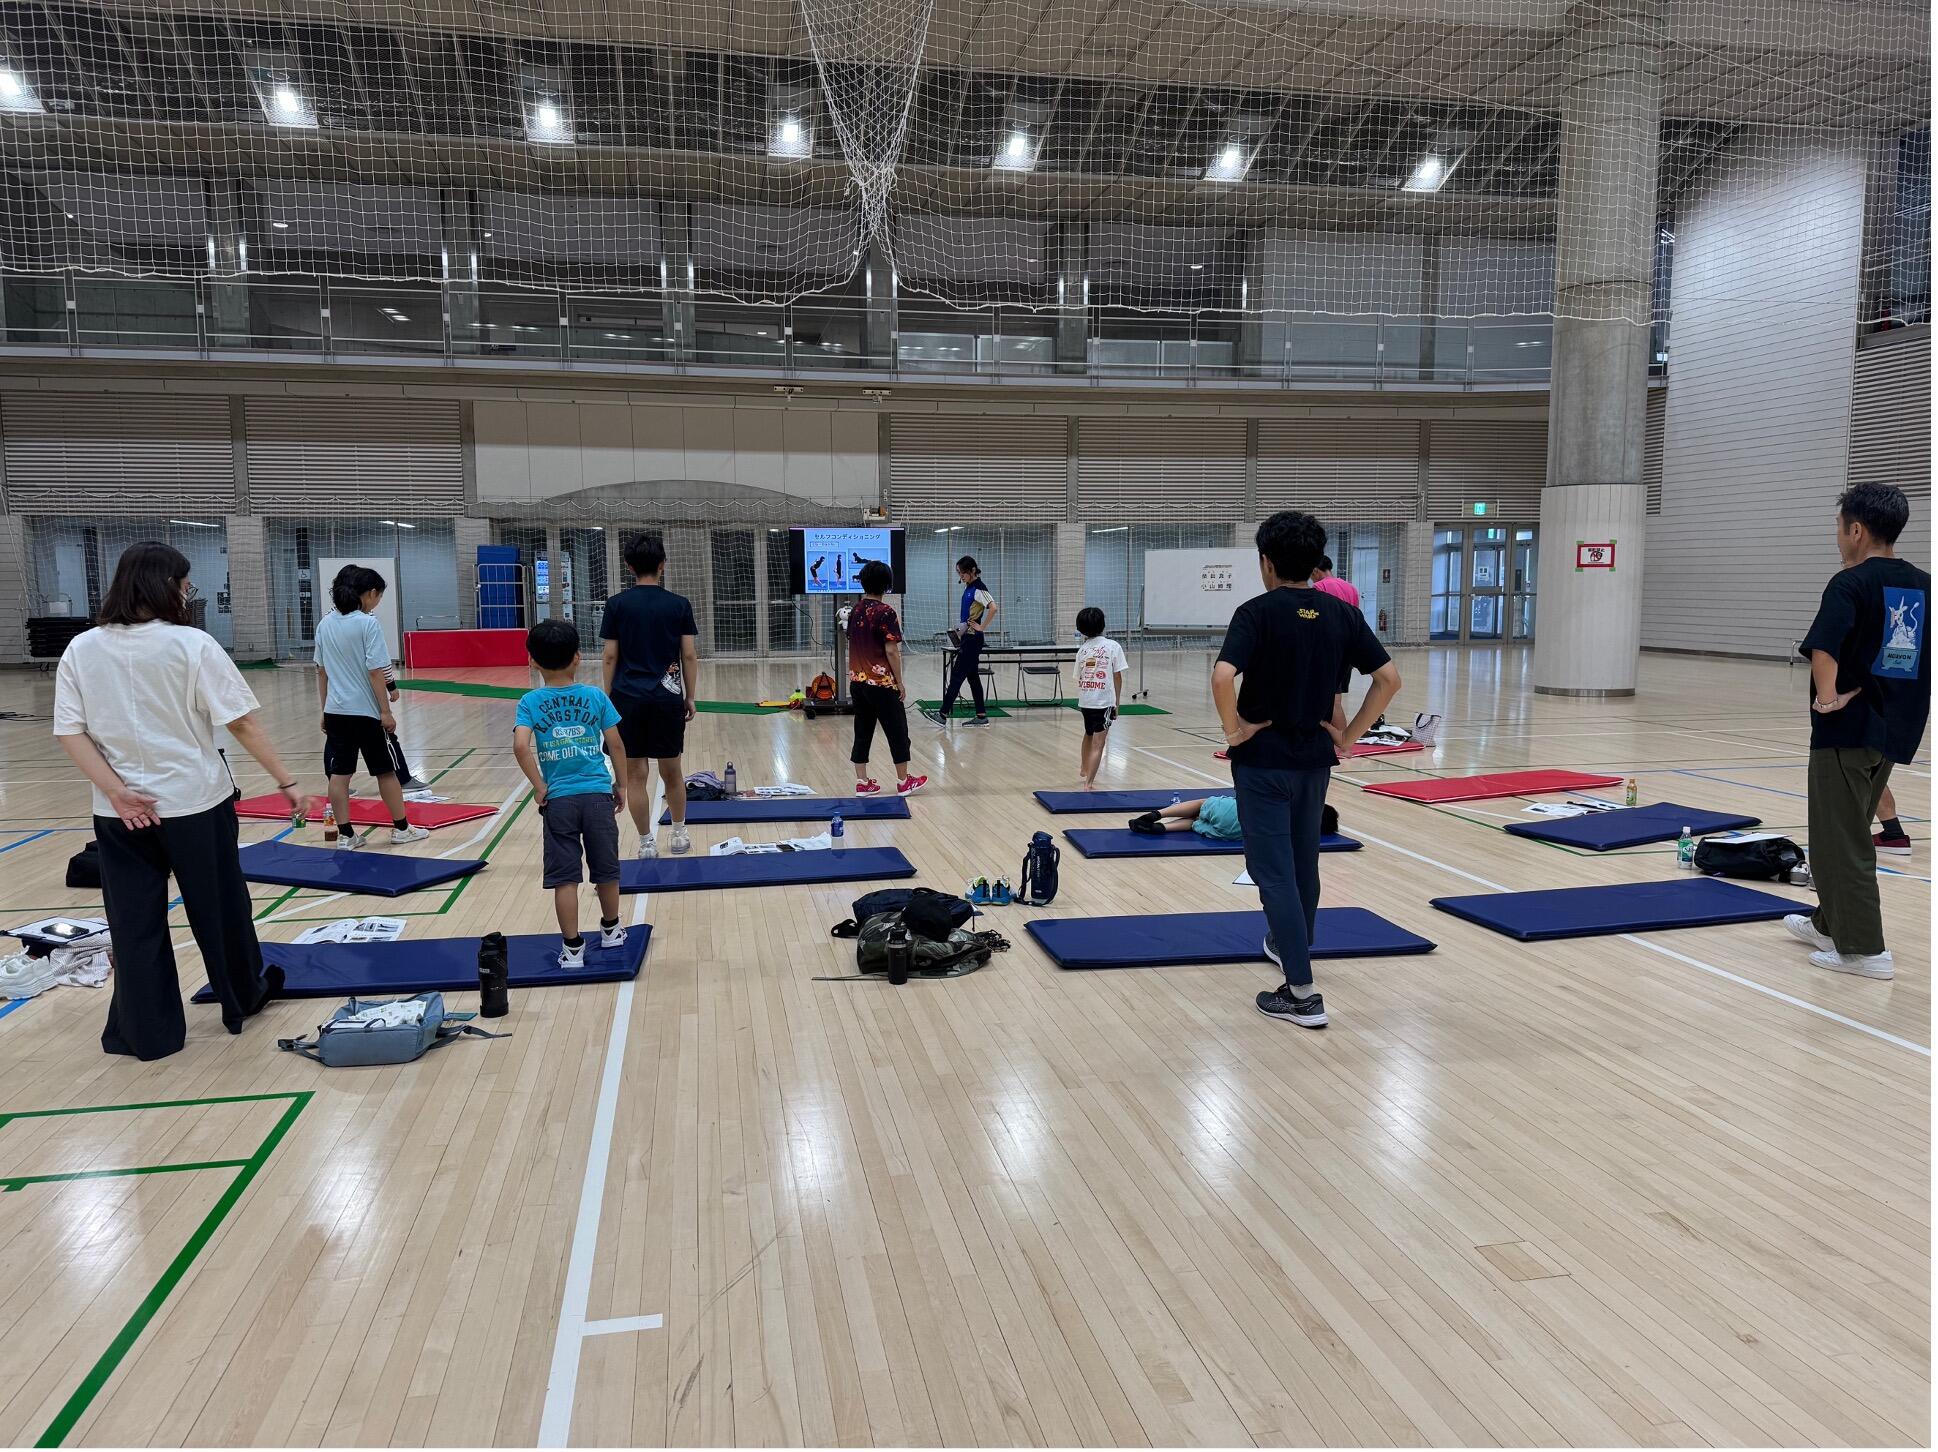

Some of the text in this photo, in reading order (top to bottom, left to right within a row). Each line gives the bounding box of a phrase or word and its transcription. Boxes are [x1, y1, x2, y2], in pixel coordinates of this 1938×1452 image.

[539, 695, 590, 714] CENTRAL
[533, 708, 599, 734] KINGSTON
[539, 749, 561, 762] COME
[562, 746, 578, 759] OUT
